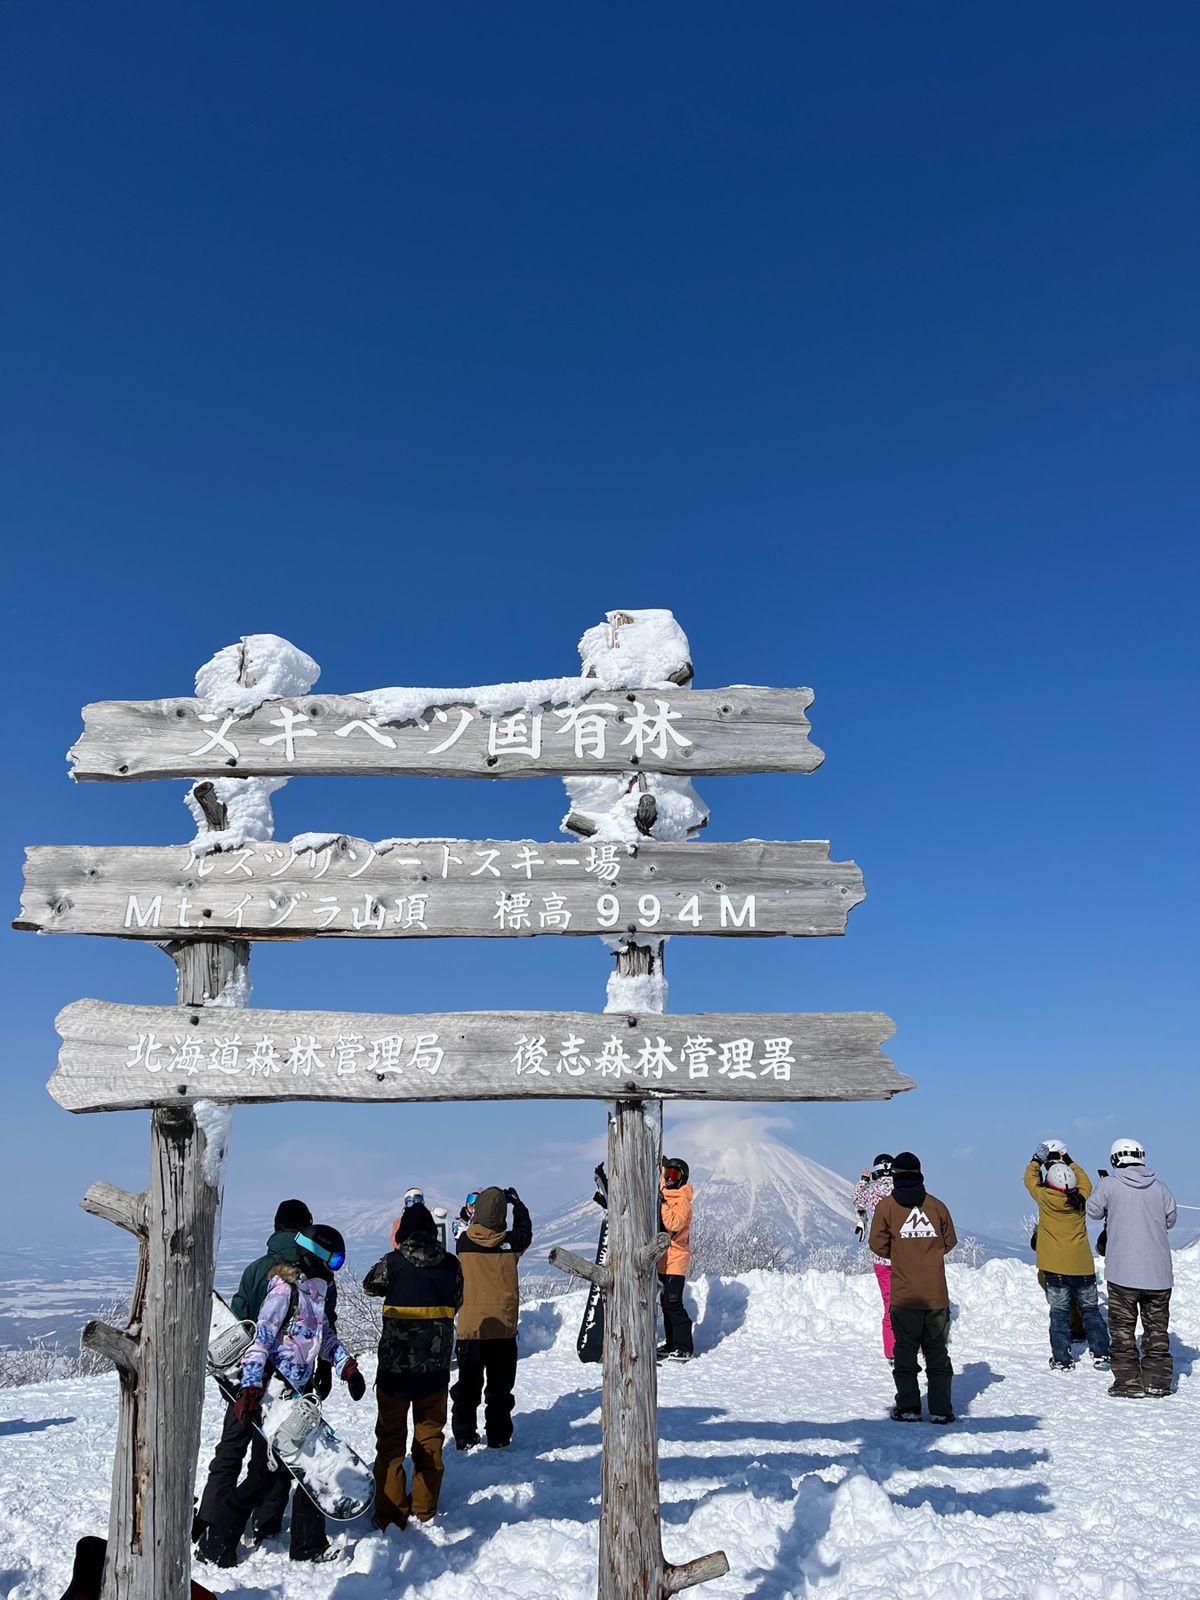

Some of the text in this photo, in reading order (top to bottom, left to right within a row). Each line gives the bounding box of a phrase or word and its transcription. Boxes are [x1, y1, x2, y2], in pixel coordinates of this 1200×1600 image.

[125, 1032, 796, 1081] 北海道森林管理局 後志森林管理署
[900, 1231, 938, 1239] NIMA
